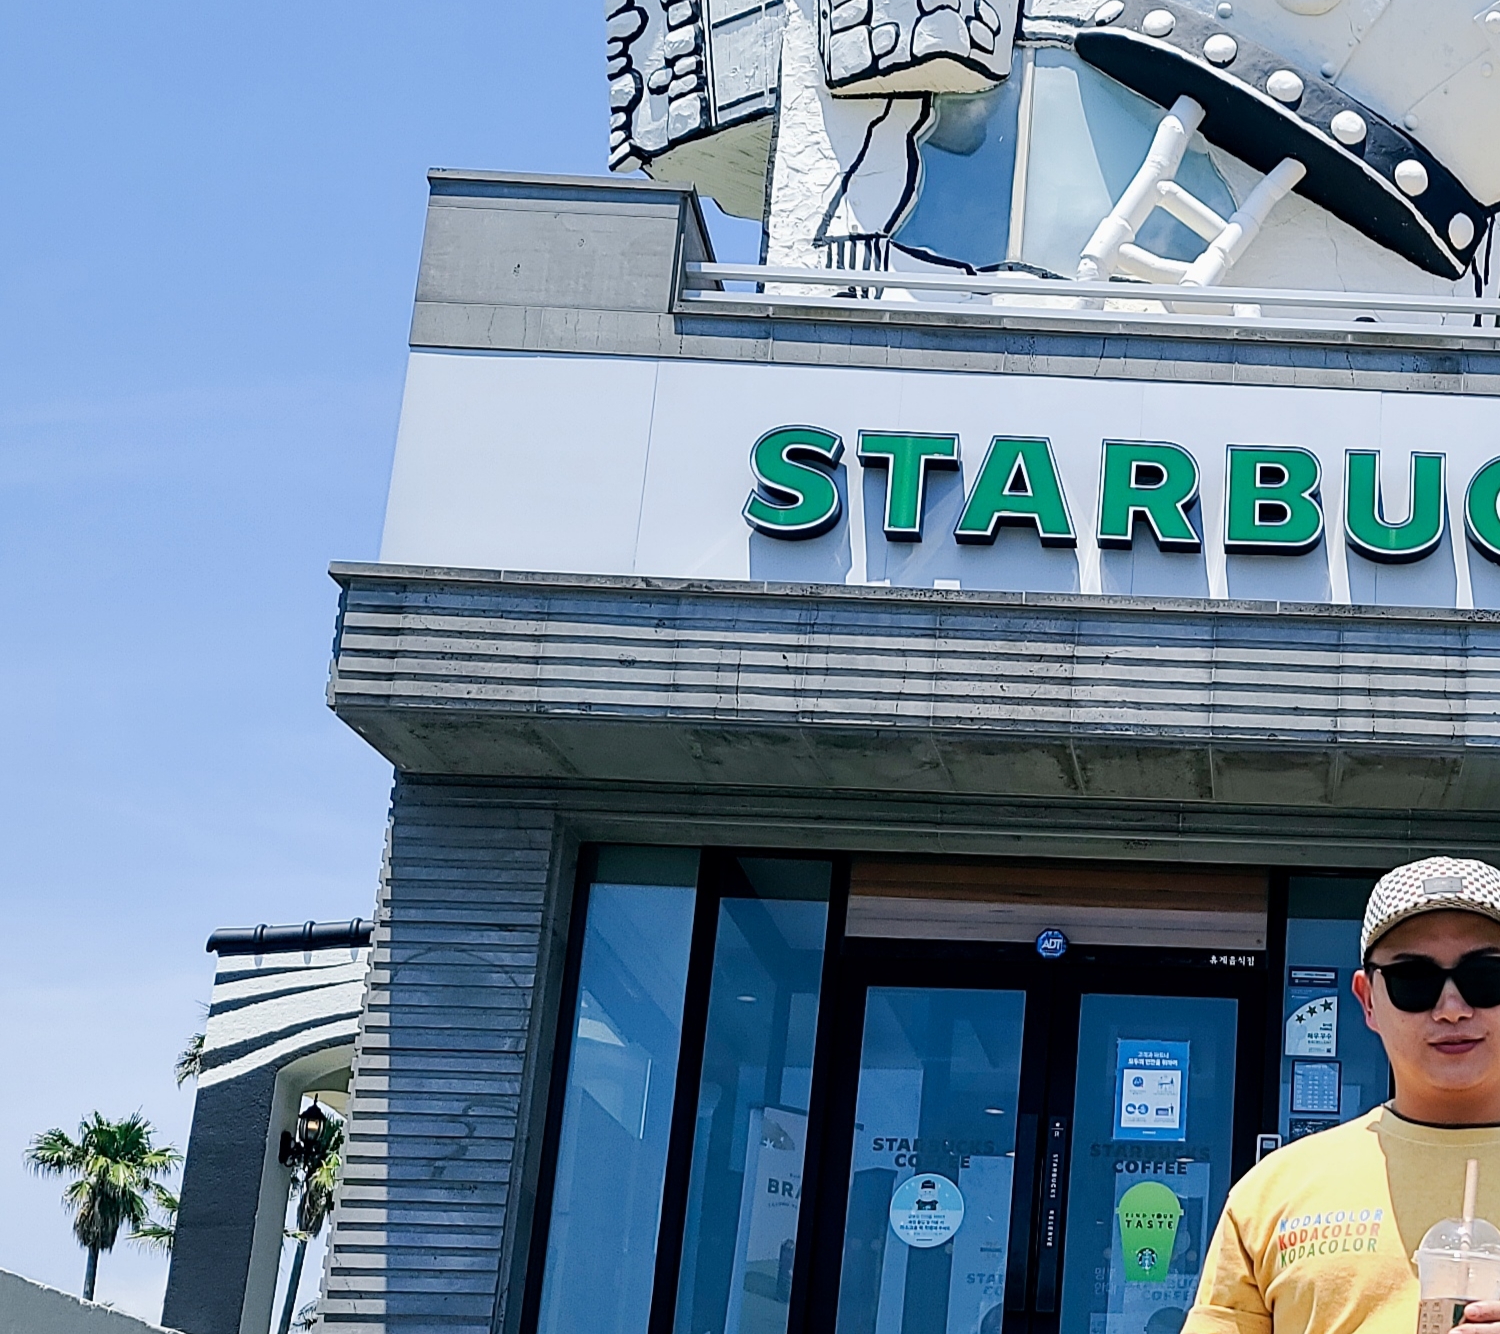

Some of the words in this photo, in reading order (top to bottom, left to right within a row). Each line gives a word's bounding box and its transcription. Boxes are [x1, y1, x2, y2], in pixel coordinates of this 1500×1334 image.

[1041, 937, 1063, 950] ADT
[1113, 1160, 1187, 1175] COFFEE
[1125, 1219, 1175, 1229] TASTE
[1279, 1209, 1383, 1233] KODACOLOR
[1278, 1223, 1380, 1251] KODACOLOR
[1280, 1238, 1377, 1268] KODACOLOR
